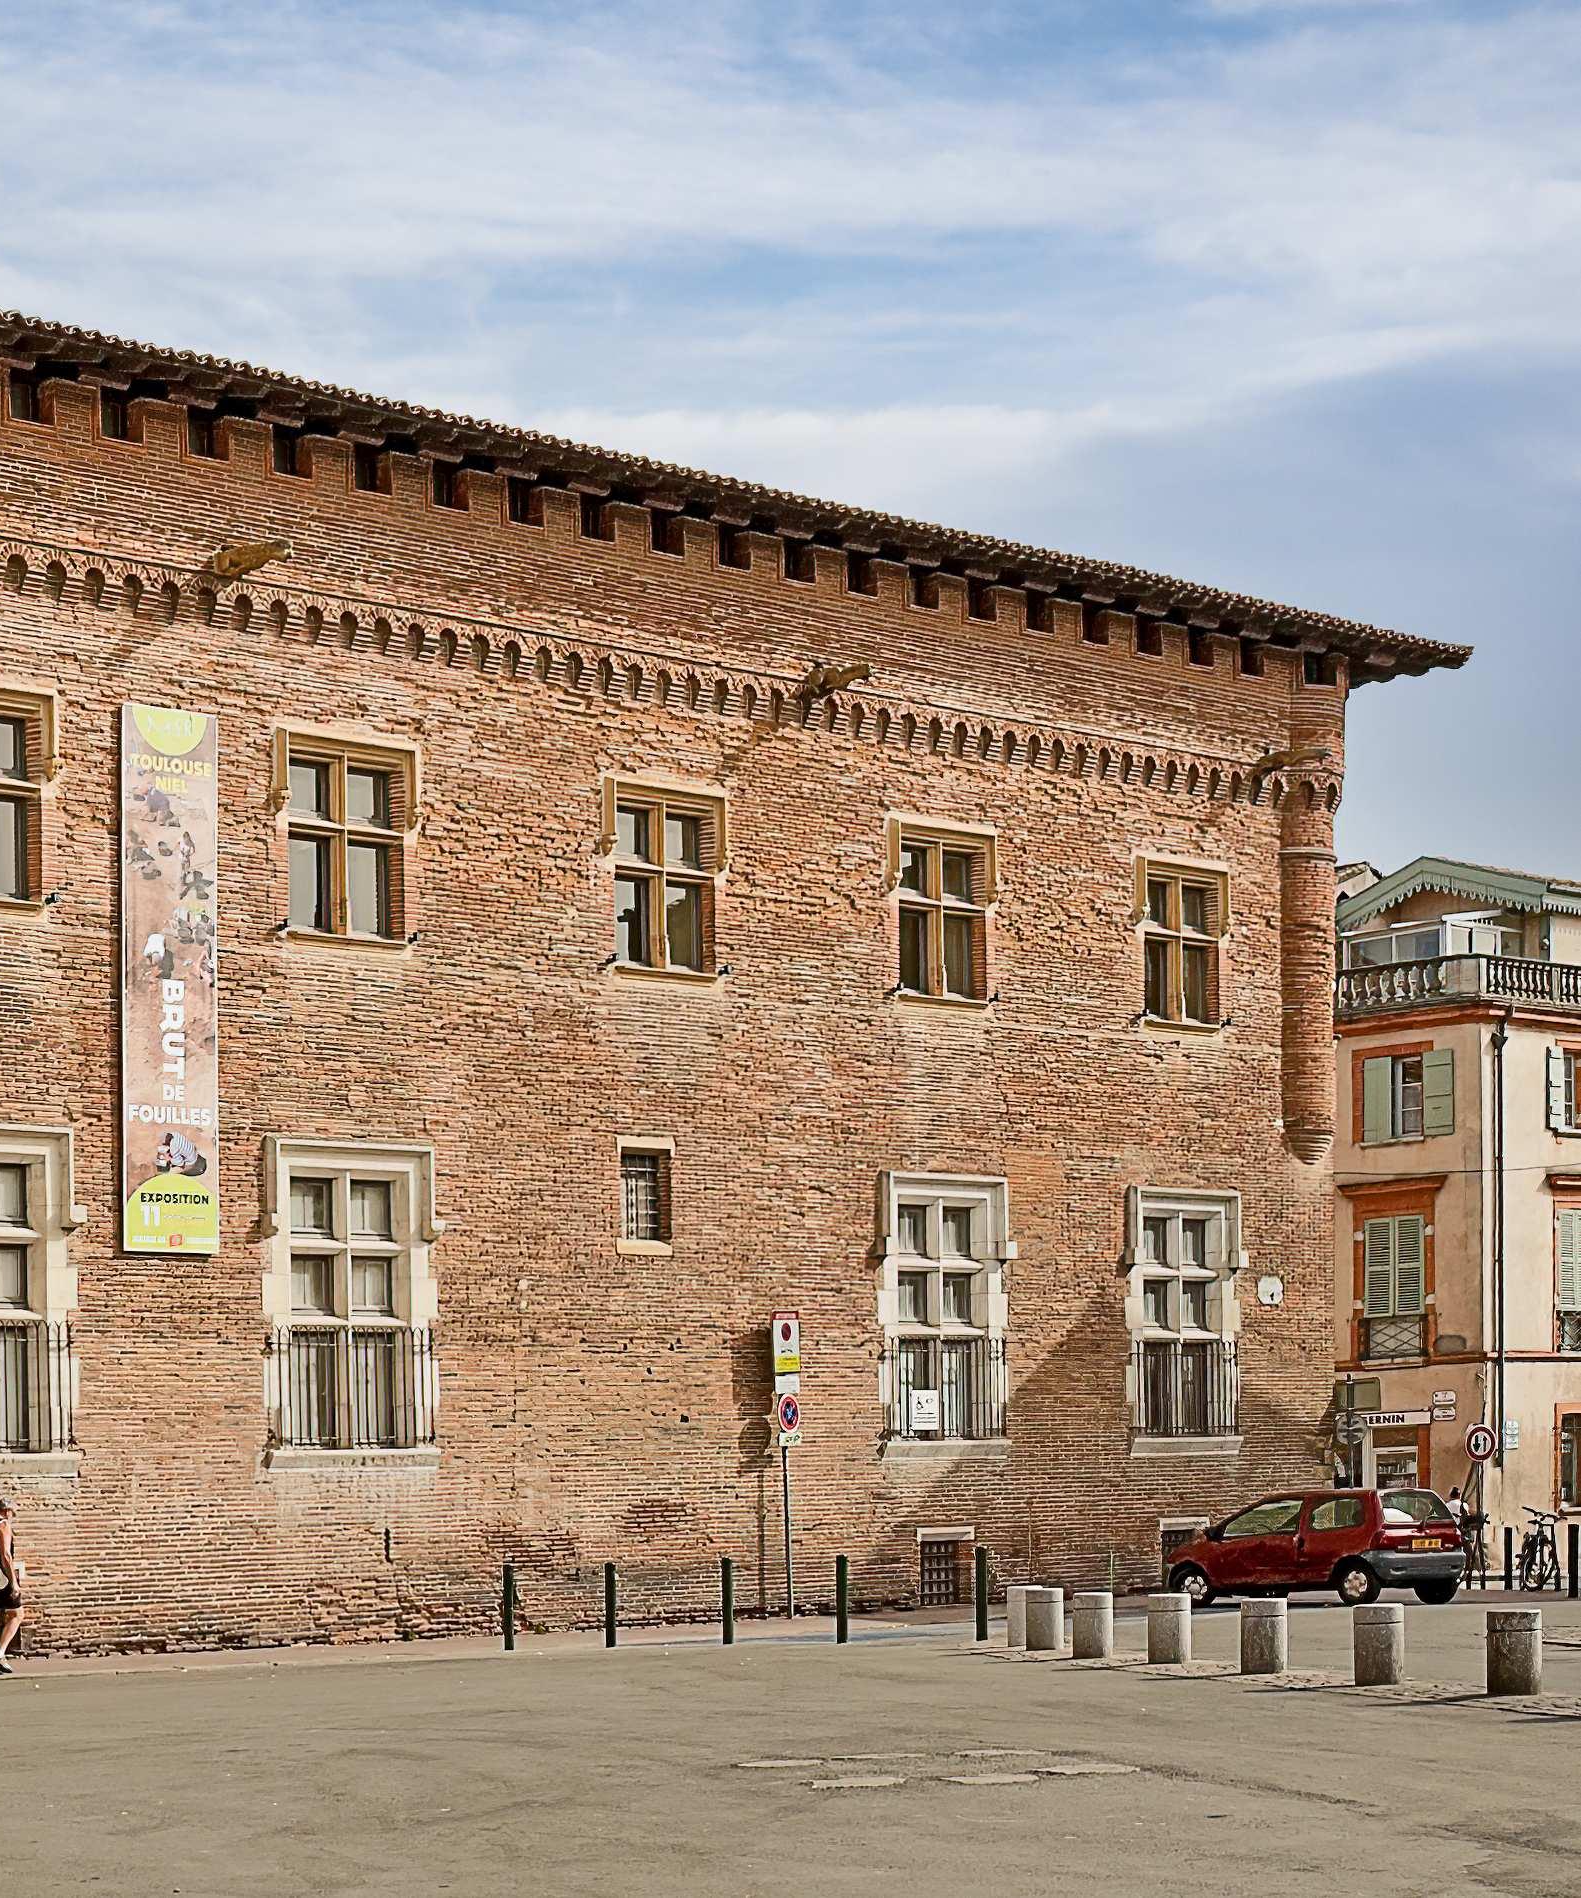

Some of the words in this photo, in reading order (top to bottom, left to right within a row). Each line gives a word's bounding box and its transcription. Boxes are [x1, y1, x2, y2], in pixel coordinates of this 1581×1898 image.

[129, 753, 213, 777] TOULOUSE
[159, 978, 186, 1079] BRUT
[163, 1083, 185, 1101] DE
[127, 1103, 213, 1127] FOUILLES
[140, 1192, 209, 1205] EXPOSITION
[1364, 1414, 1405, 1425] ERNIN
